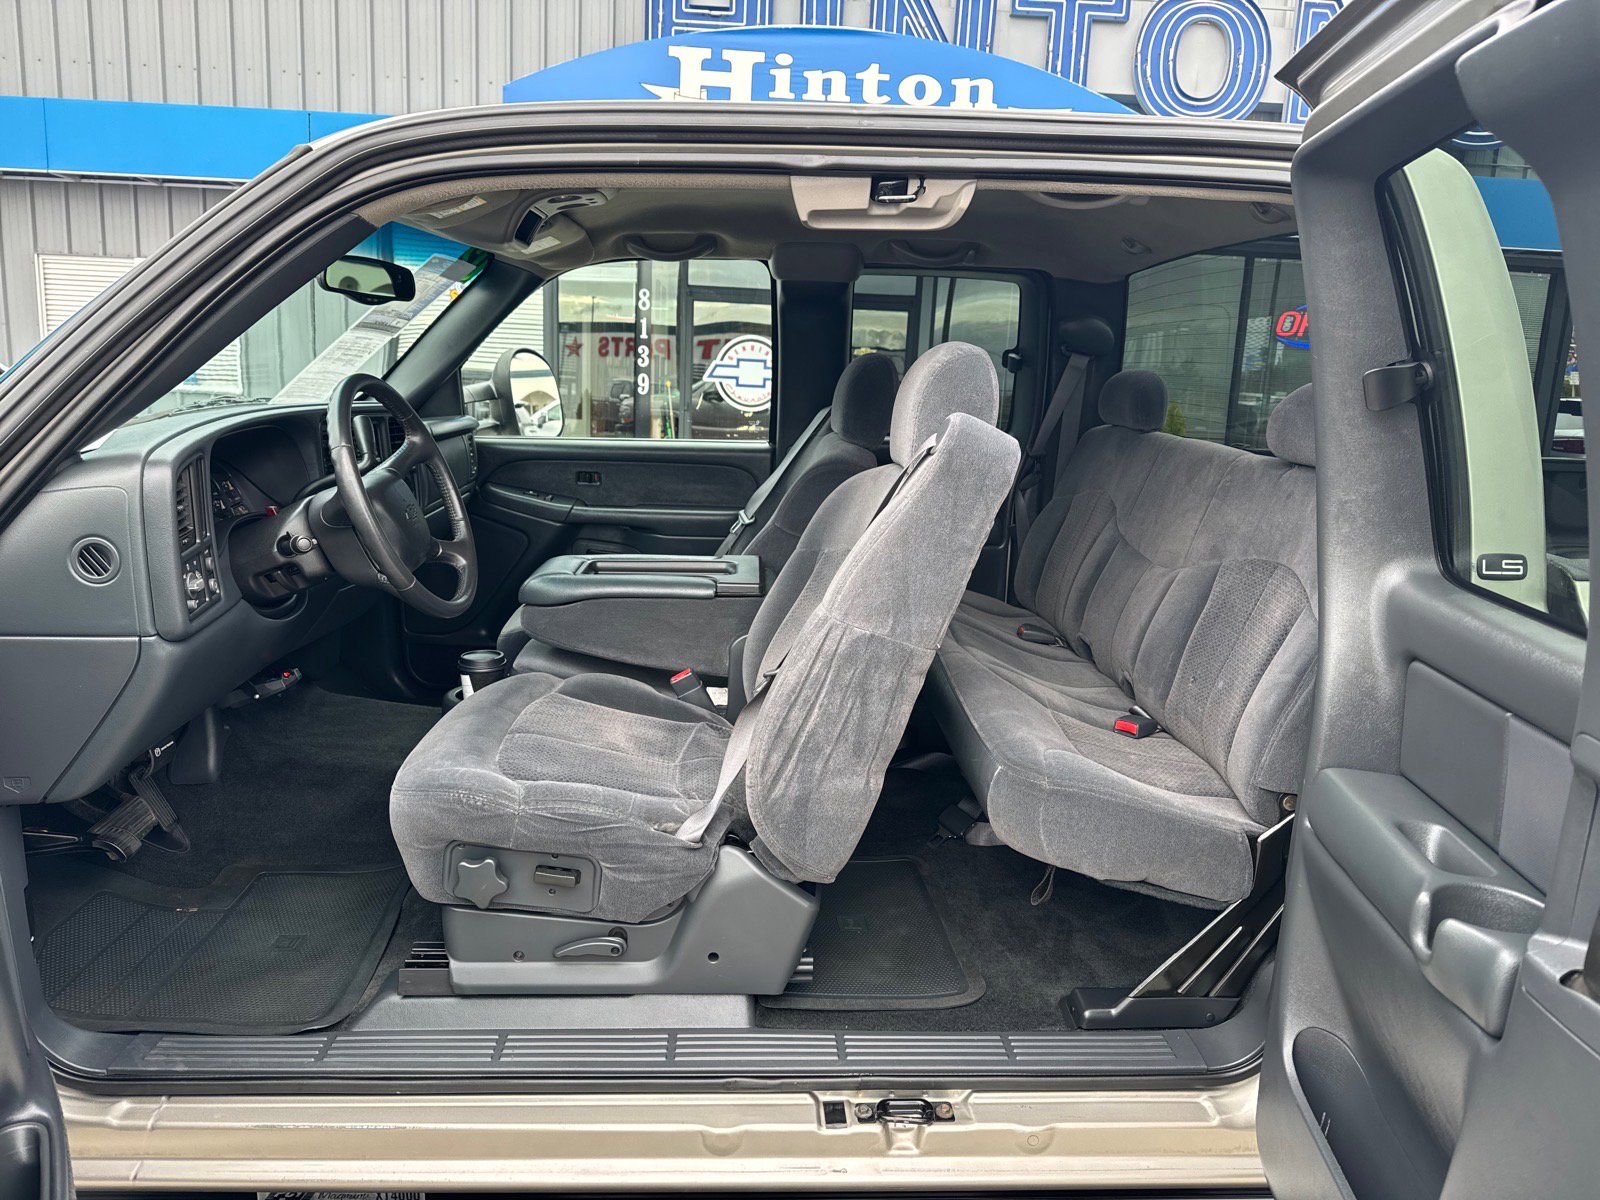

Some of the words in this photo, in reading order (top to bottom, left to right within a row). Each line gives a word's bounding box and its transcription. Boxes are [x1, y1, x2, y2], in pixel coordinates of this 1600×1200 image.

[668, 45, 998, 109] Hinton
[637, 288, 650, 395] 8139
[1482, 559, 1524, 575] LS
